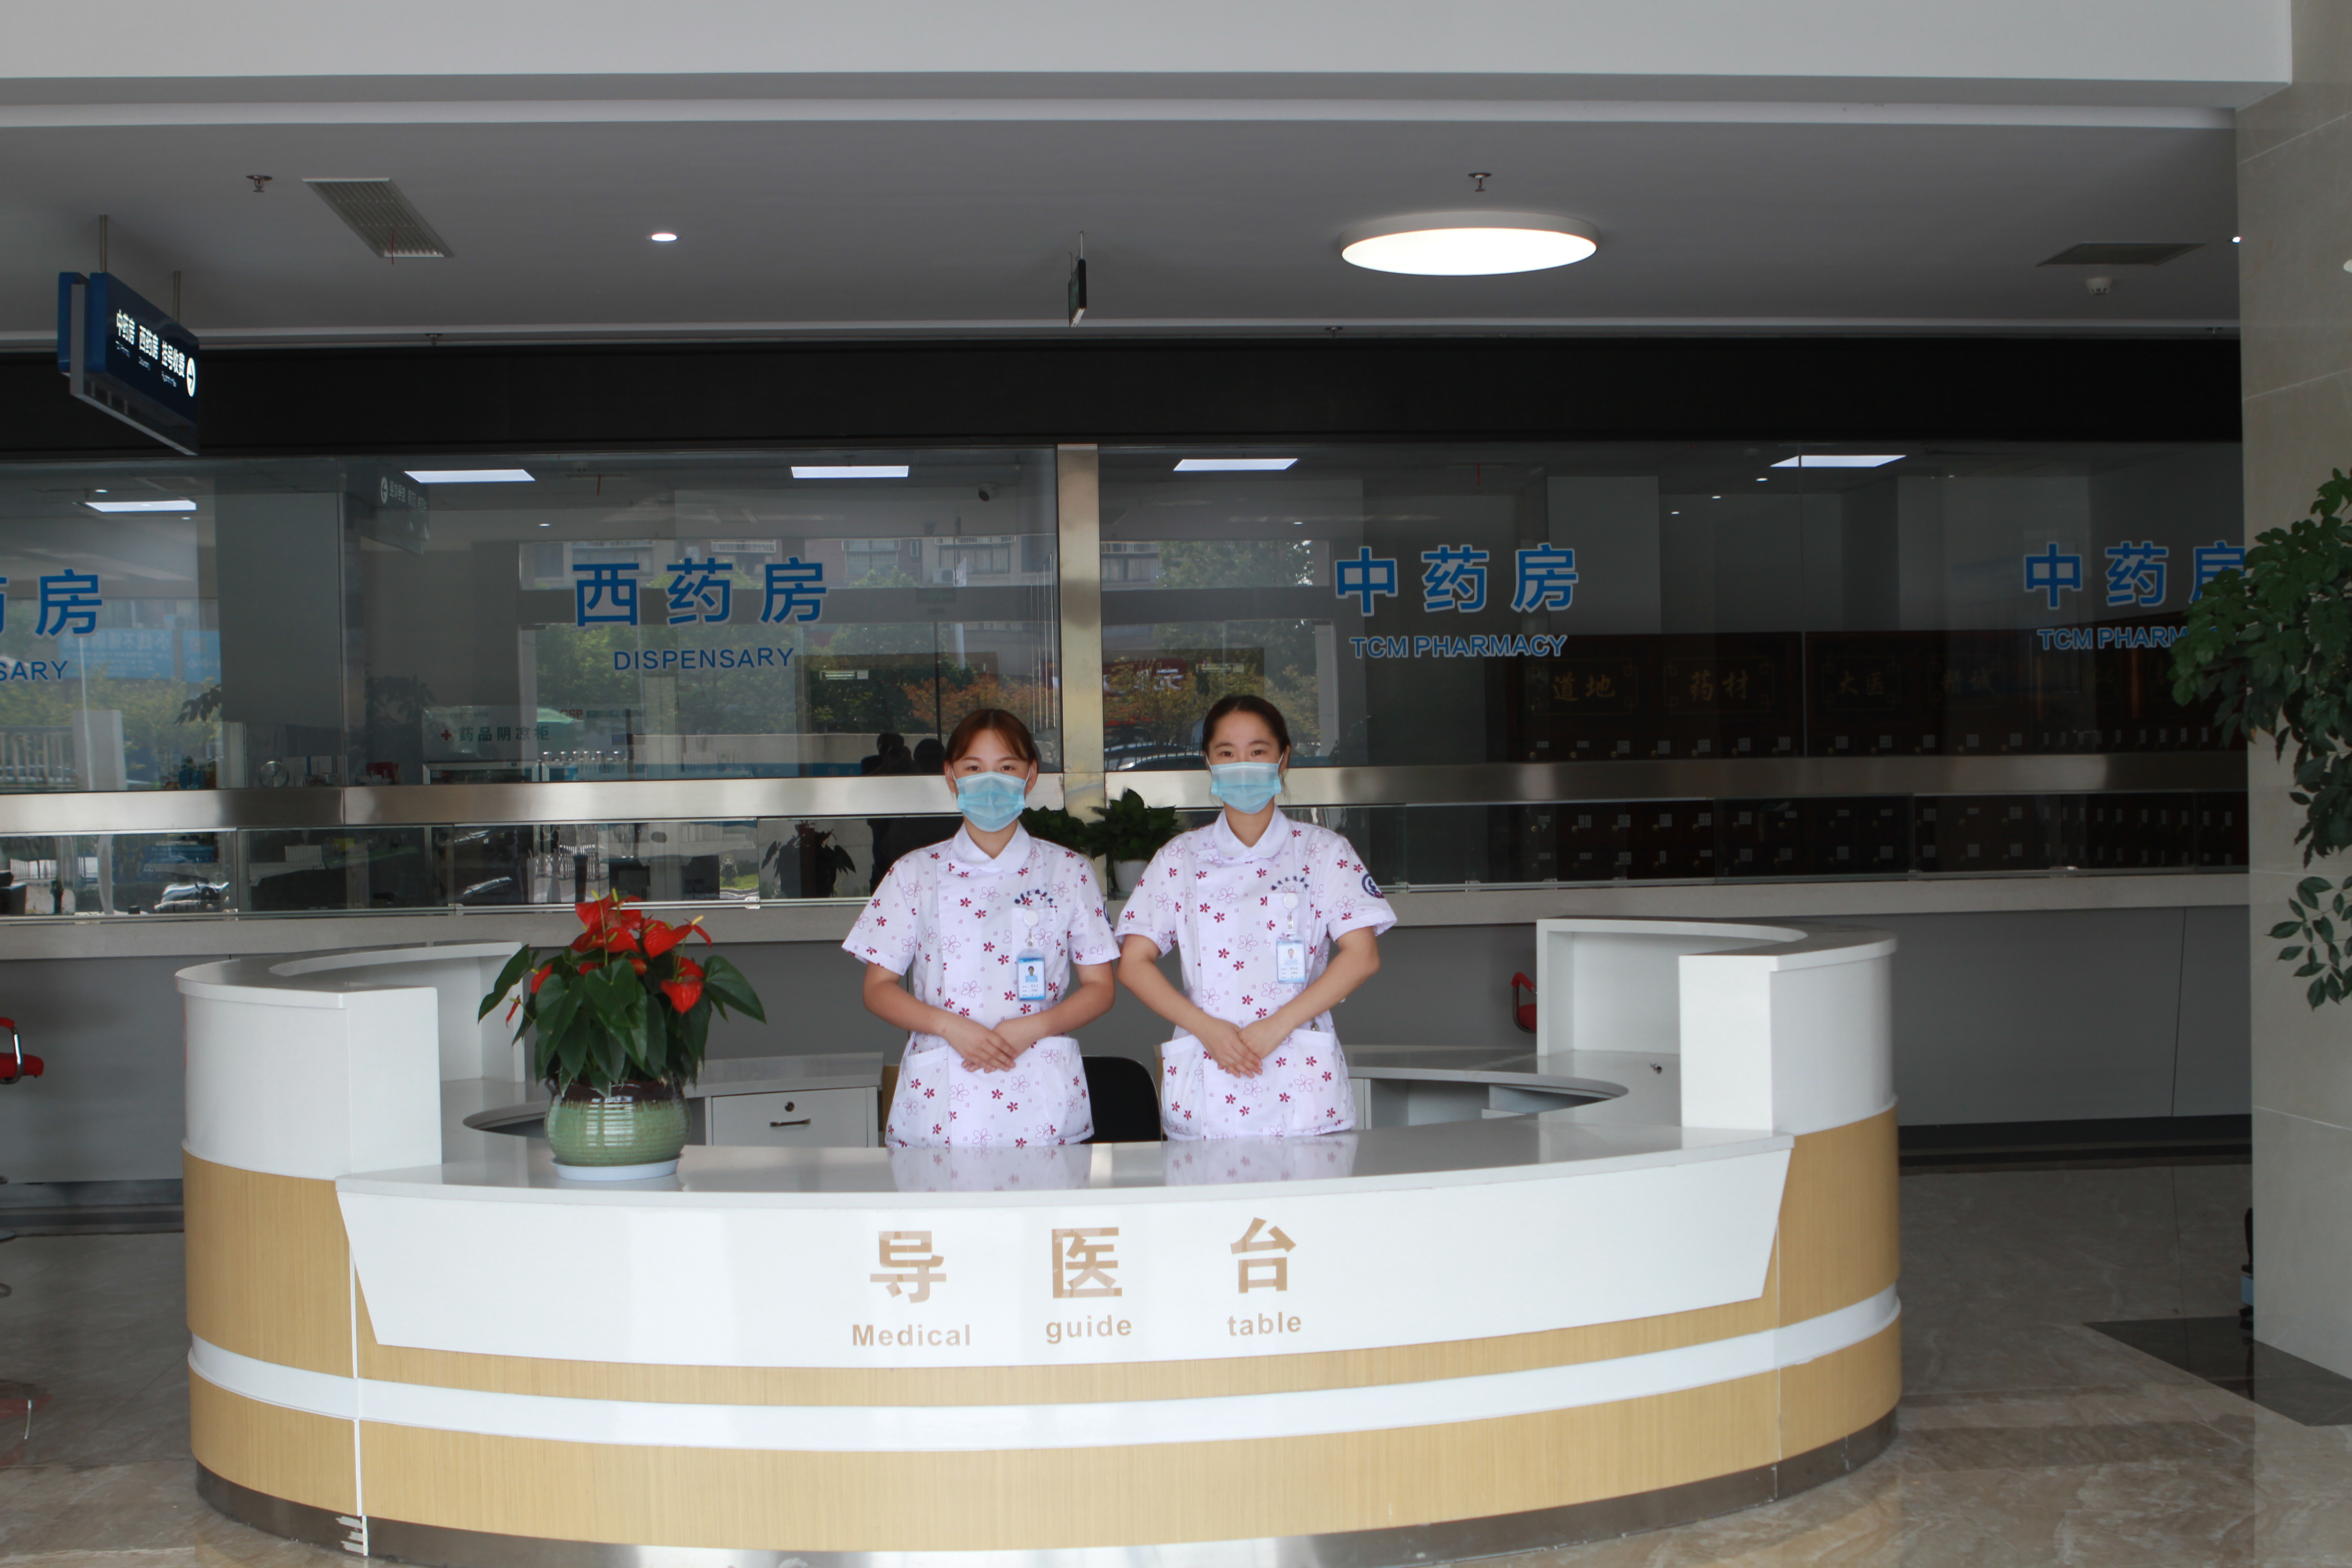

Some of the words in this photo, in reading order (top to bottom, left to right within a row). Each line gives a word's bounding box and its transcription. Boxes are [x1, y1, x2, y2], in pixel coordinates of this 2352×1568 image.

[116, 309, 136, 346] 中药房
[139, 325, 159, 361] 西药房
[573, 557, 826, 627] 西药房
[1336, 544, 1578, 616] 中药房
[0, 568, 103, 636] 房
[1350, 636, 1408, 658] TCM
[1414, 634, 1567, 657] PHARMACY
[2038, 627, 2093, 650] TCM
[2098, 626, 2239, 649] PHARM
[614, 647, 794, 671] DISPENSARY
[1552, 671, 1616, 702] 道地
[459, 726, 550, 742] 药品阴凉柜
[870, 1217, 1296, 1303] 导医台
[852, 1324, 971, 1347] Medical
[1046, 1314, 1132, 1345] guide
[1227, 1311, 1302, 1337] table
